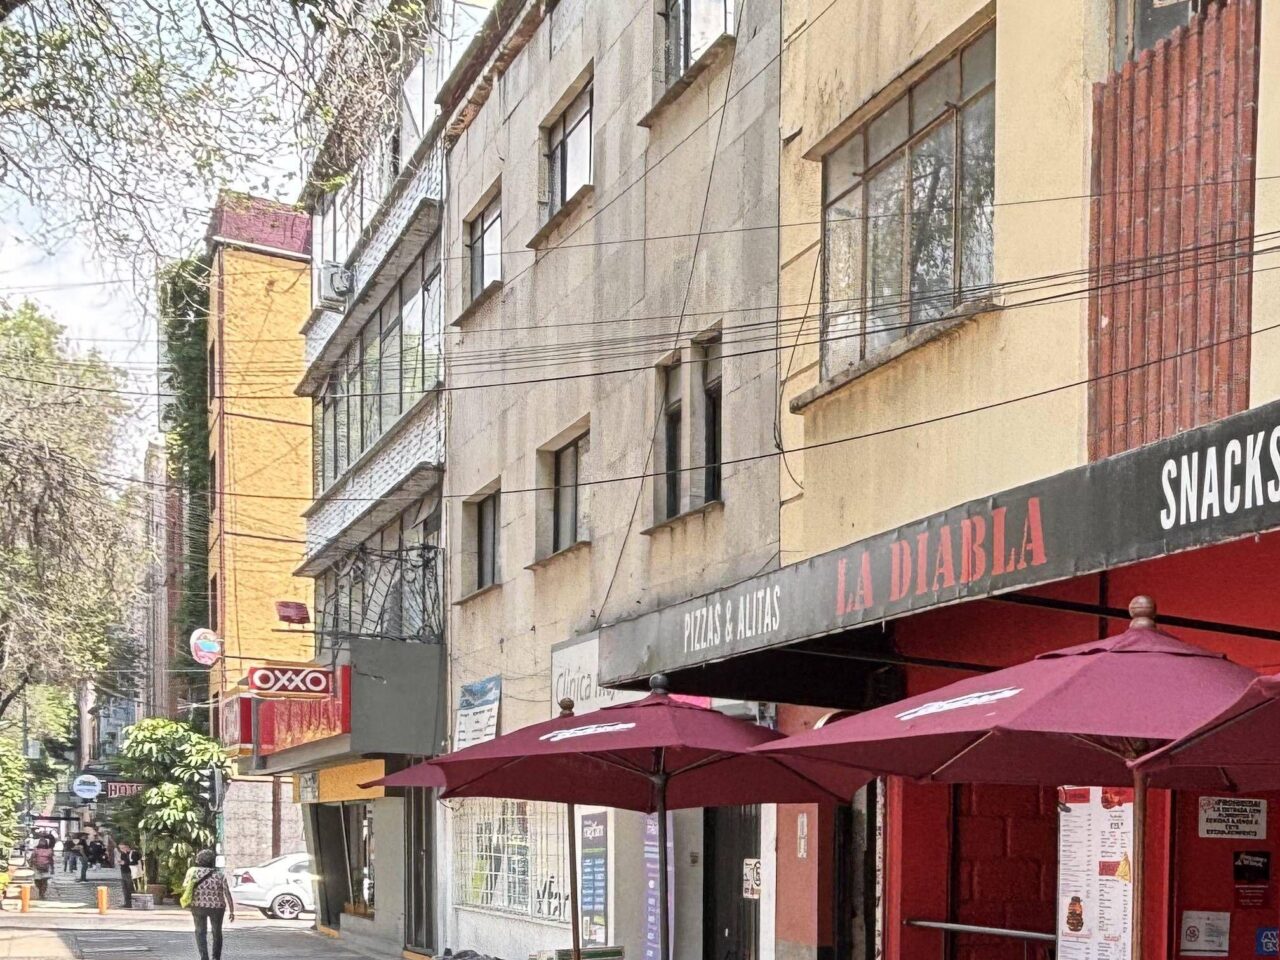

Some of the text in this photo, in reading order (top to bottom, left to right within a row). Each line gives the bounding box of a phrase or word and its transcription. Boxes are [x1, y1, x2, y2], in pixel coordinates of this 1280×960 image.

[835, 496, 1048, 617] LA DIABLA
[684, 584, 781, 654] PIZZAS & ALITAS
[252, 668, 327, 692] OXXO
[108, 782, 143, 798] HOT
